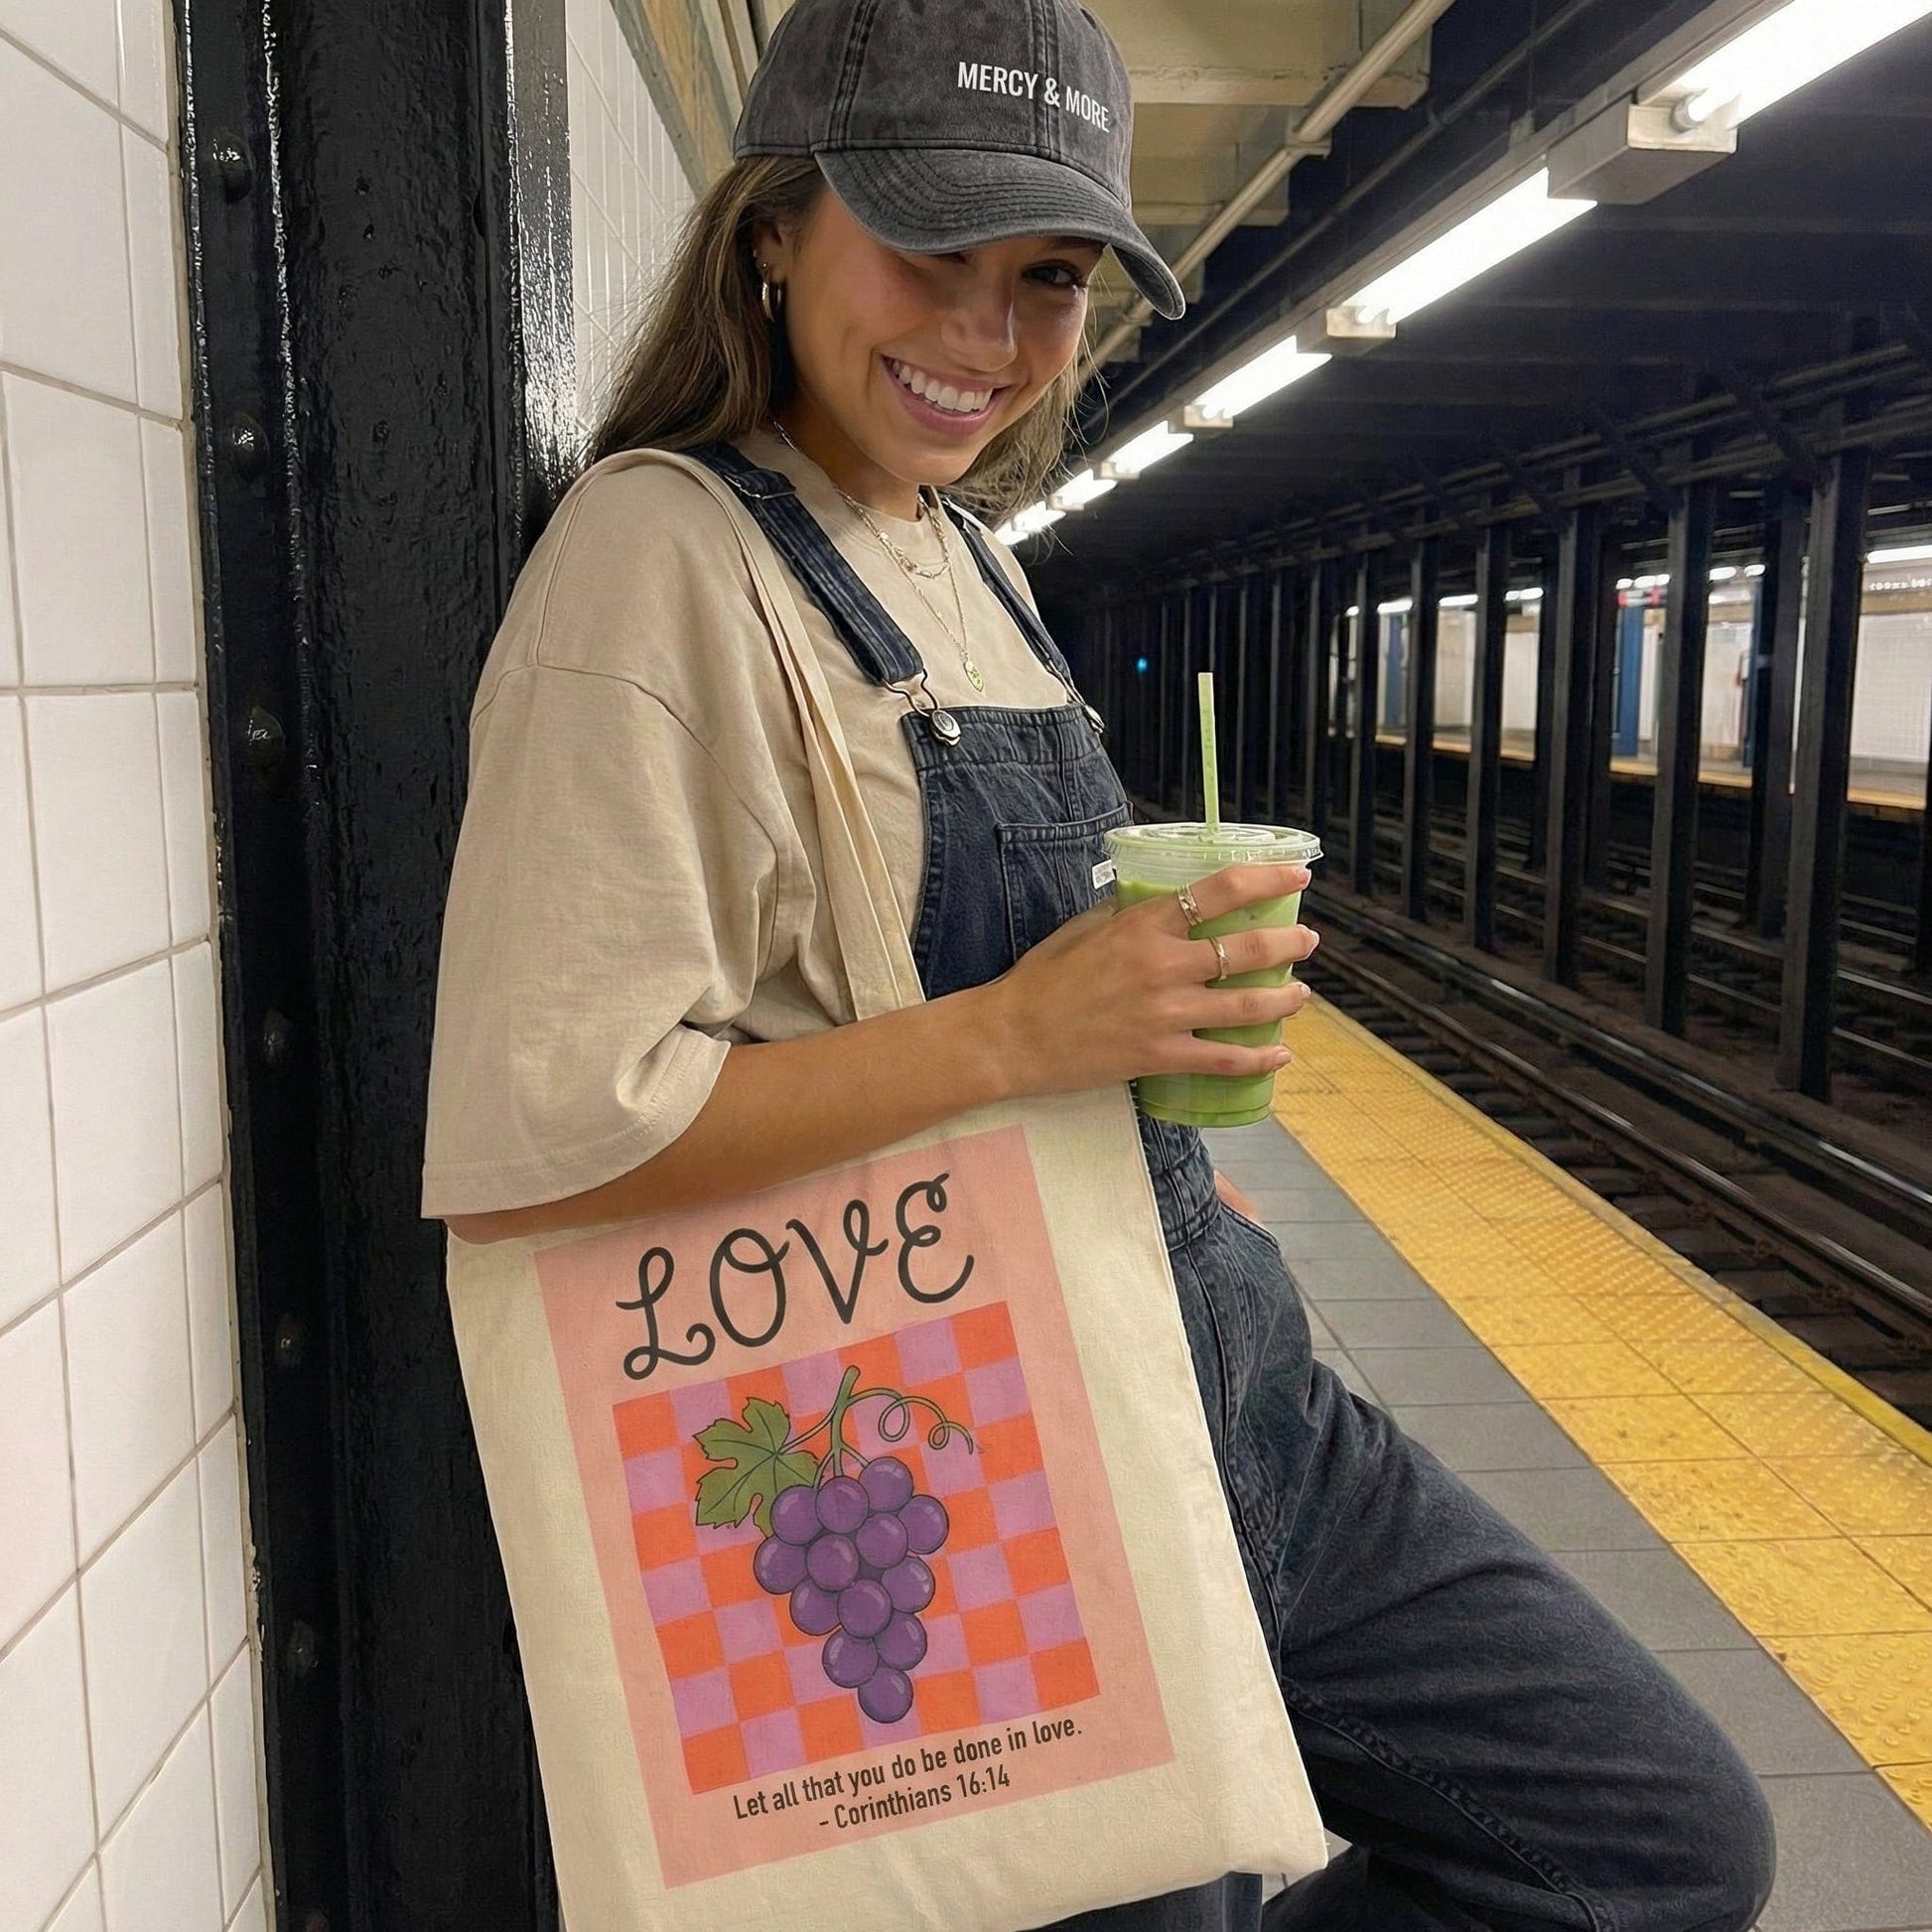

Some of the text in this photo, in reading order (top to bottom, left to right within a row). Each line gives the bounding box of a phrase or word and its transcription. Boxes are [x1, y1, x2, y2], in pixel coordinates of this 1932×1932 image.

[957, 62, 1110, 132] MERCY & MORE
[616, 1173, 975, 1380] LOVE
[733, 1716, 1082, 1820] Let all that you do be done in love.
[833, 1784, 952, 1829] Corinthians
[956, 1764, 1011, 1799] 16:14
